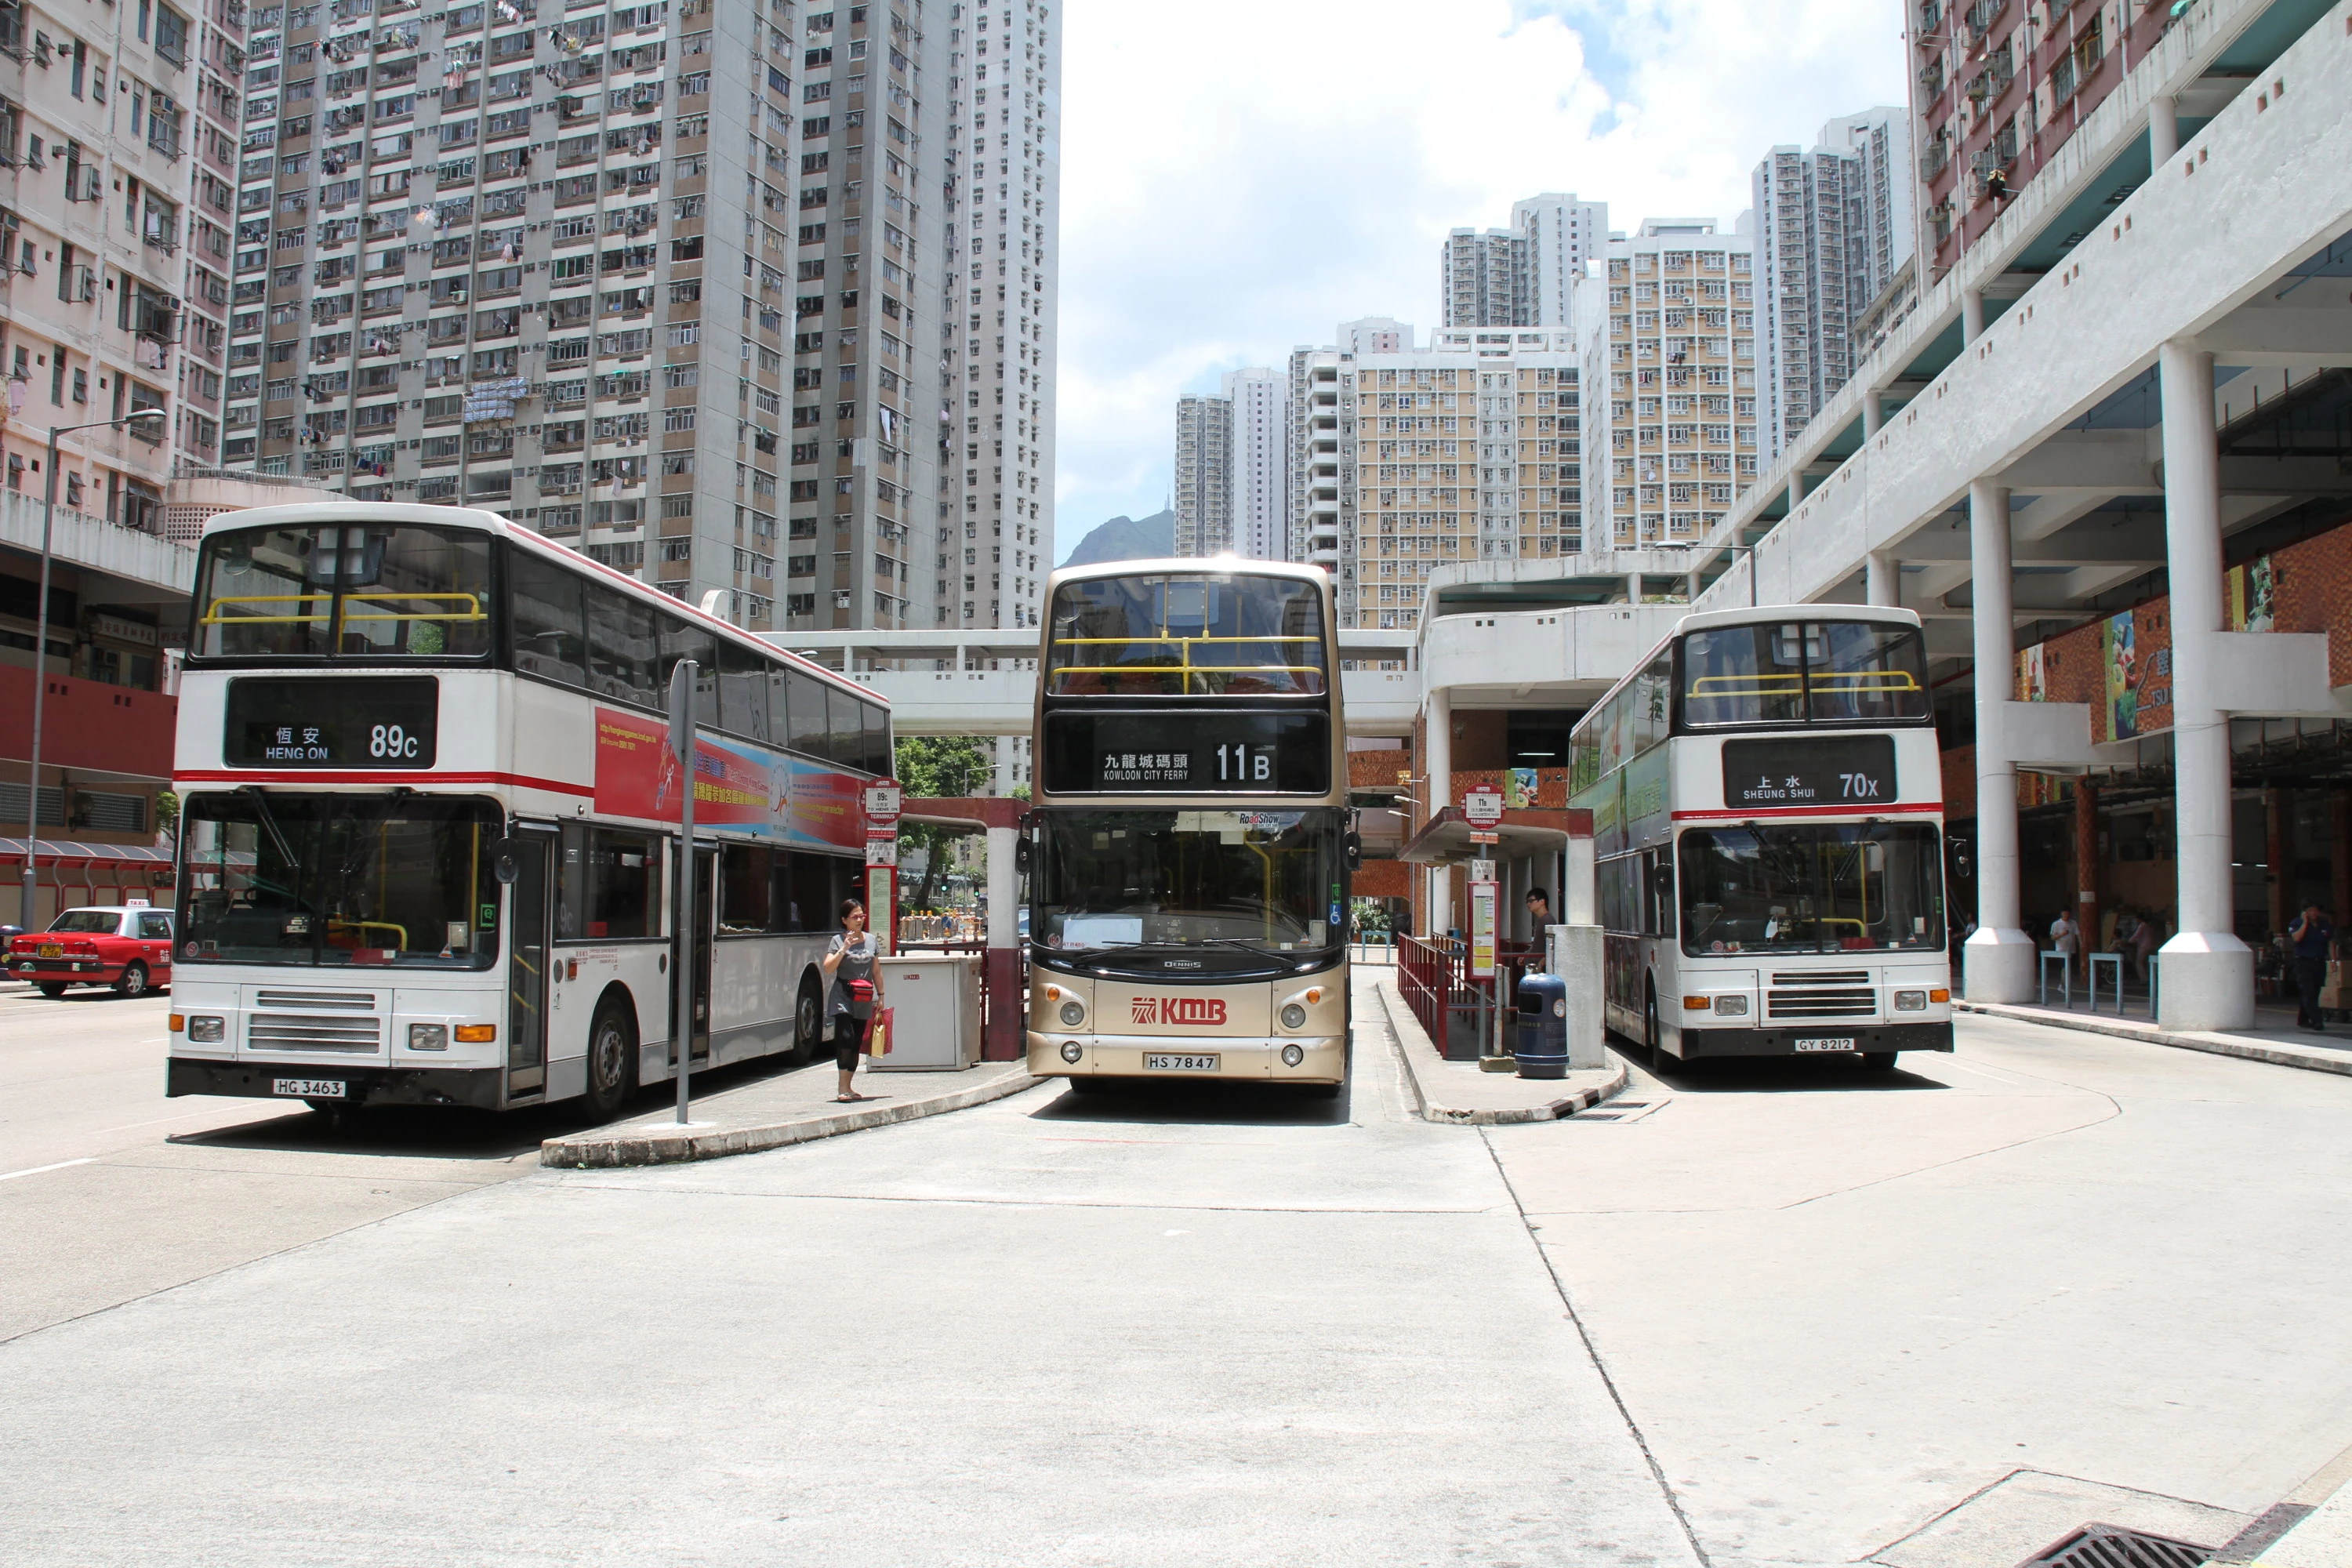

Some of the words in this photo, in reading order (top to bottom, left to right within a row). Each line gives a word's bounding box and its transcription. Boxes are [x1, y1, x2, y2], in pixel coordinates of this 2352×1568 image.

[276, 728, 320, 744] 恆安
[266, 747, 304, 760] HENG
[307, 747, 328, 760] ON
[1105, 754, 1188, 769] 九龍城碼頭
[1217, 744, 1270, 781] 11B
[1104, 771, 1141, 781] KOWLOON
[1144, 771, 1160, 781] CITY
[1164, 771, 1188, 780] FERRY
[1757, 775, 1800, 789] 上水
[1744, 789, 1785, 800] SHEUNG
[1791, 789, 1814, 798] SHUI
[1240, 813, 1279, 824] RoadShow
[1799, 1040, 1815, 1050] GY
[1820, 1040, 1851, 1050] 8212
[1149, 1056, 1168, 1068] HS
[1174, 1057, 1214, 1069] 7847
[278, 1080, 297, 1093] HG
[302, 1081, 340, 1094] 3463
